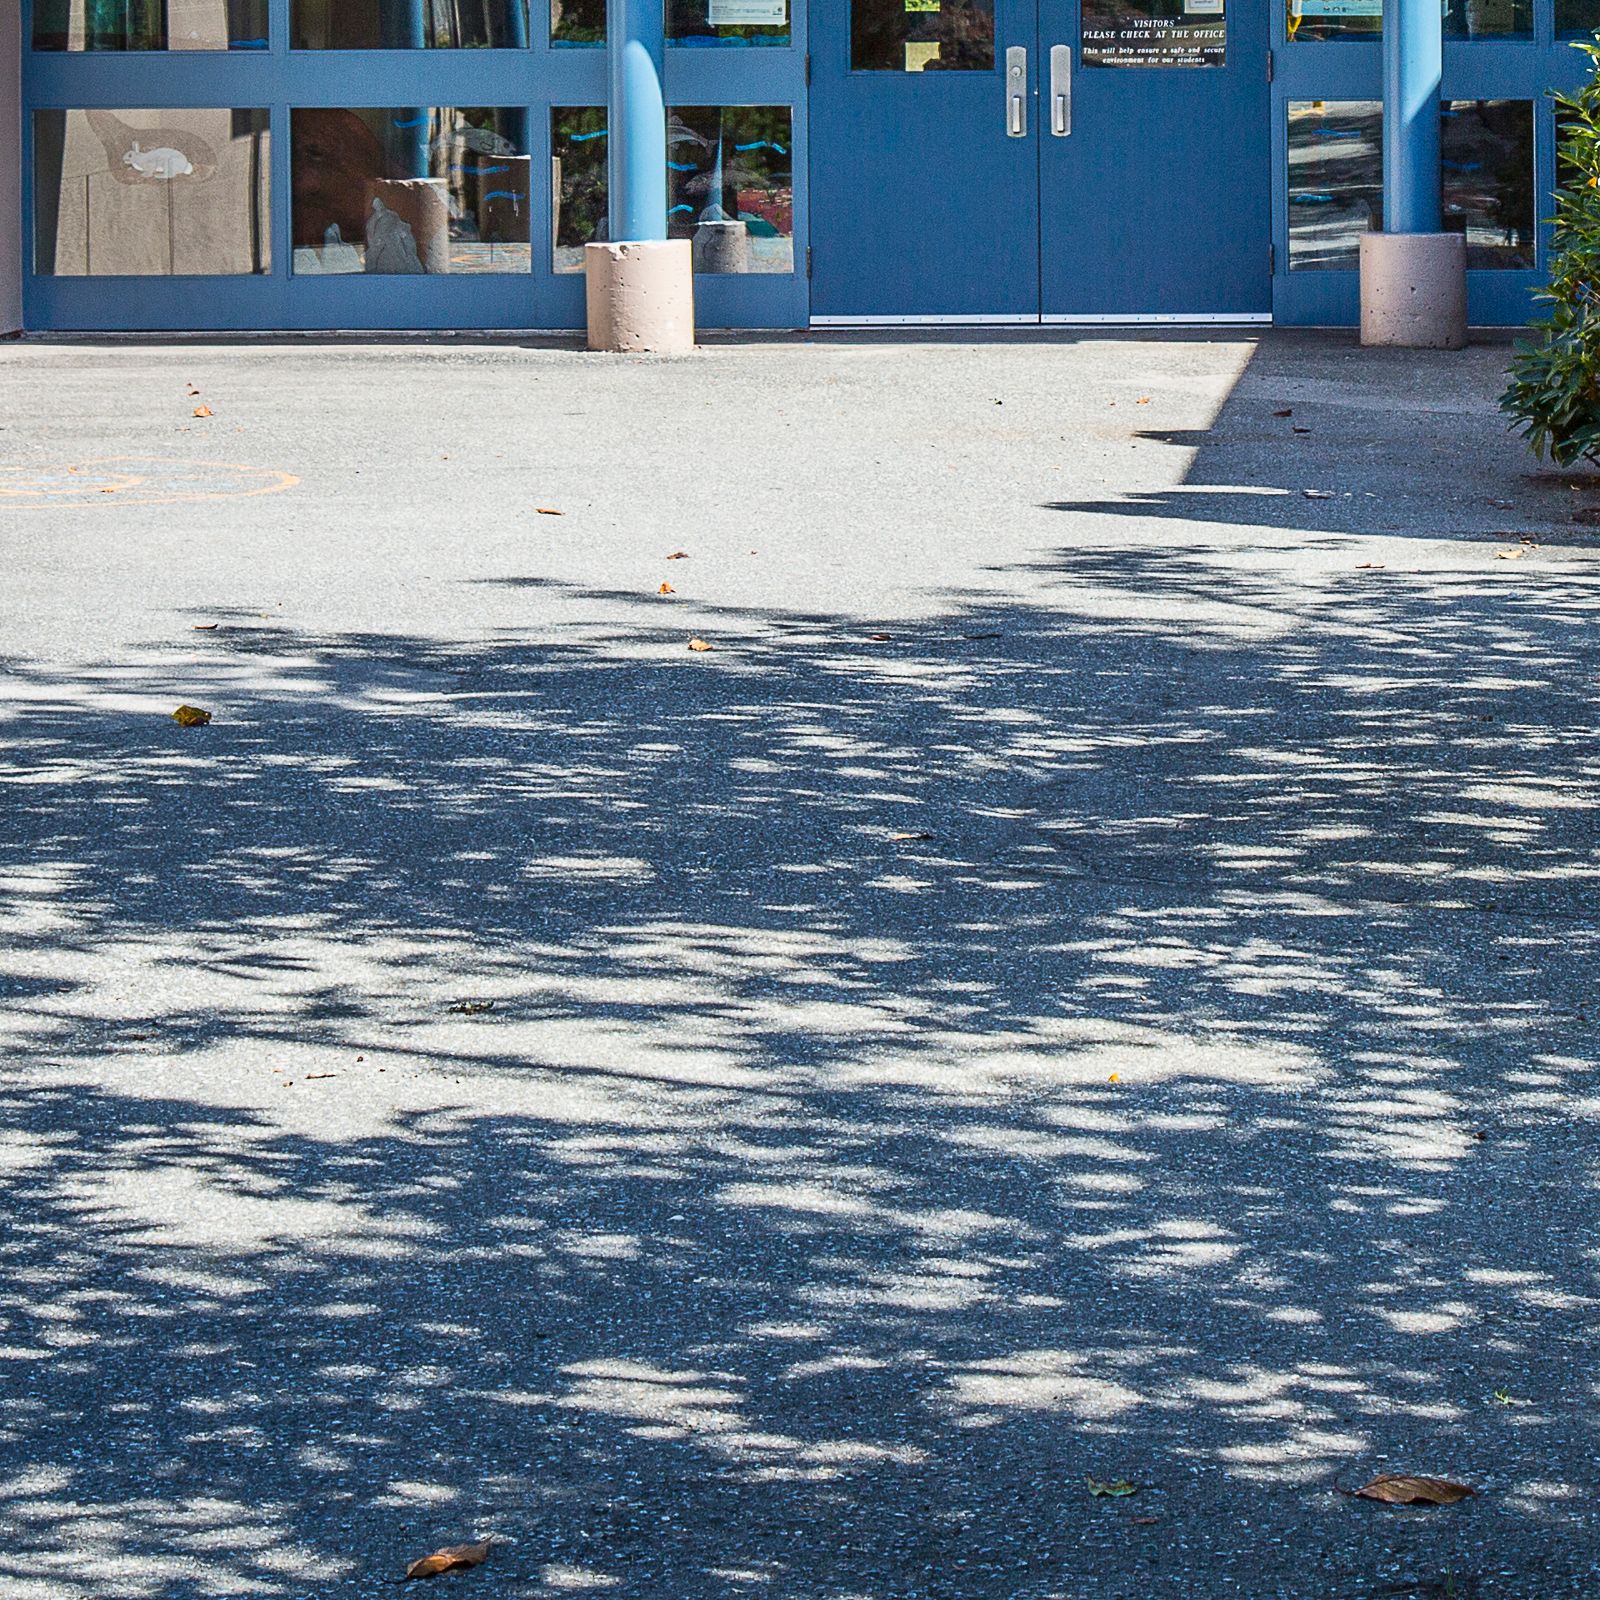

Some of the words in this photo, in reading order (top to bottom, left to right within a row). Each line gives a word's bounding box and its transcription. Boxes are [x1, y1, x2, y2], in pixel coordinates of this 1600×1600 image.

[1134, 19, 1175, 28] VISITORS
[1083, 30, 1116, 39] PLEASE
[1120, 30, 1150, 39] CHECK
[1155, 30, 1166, 39] AT
[1171, 30, 1189, 38] THE
[1194, 30, 1224, 38] OFFICE
[1119, 47, 1134, 56] help
[1170, 47, 1185, 56] safe
